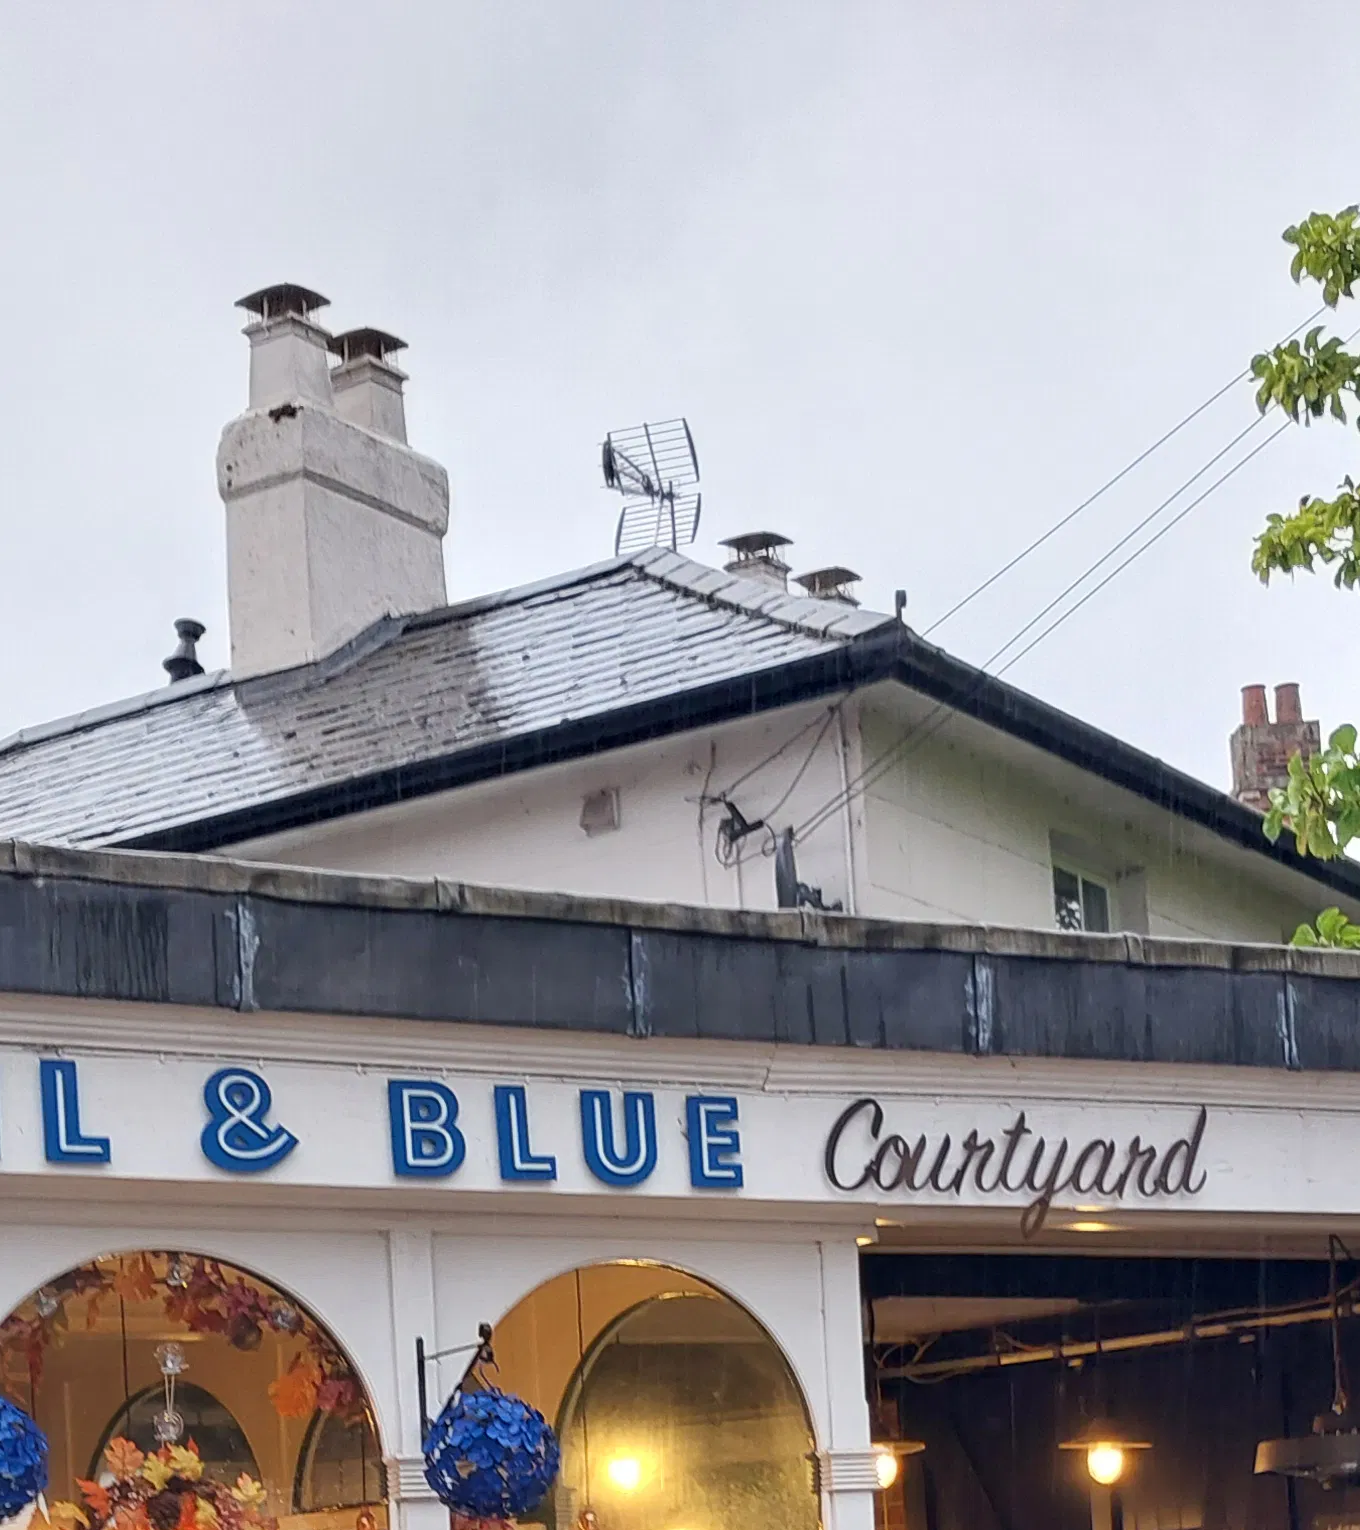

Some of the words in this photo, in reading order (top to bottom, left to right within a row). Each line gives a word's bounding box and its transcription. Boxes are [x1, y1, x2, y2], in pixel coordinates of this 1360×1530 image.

[201, 1067, 300, 1174] &
[387, 1079, 745, 1190] BLUE
[825, 1099, 1207, 1240] Courtyard
